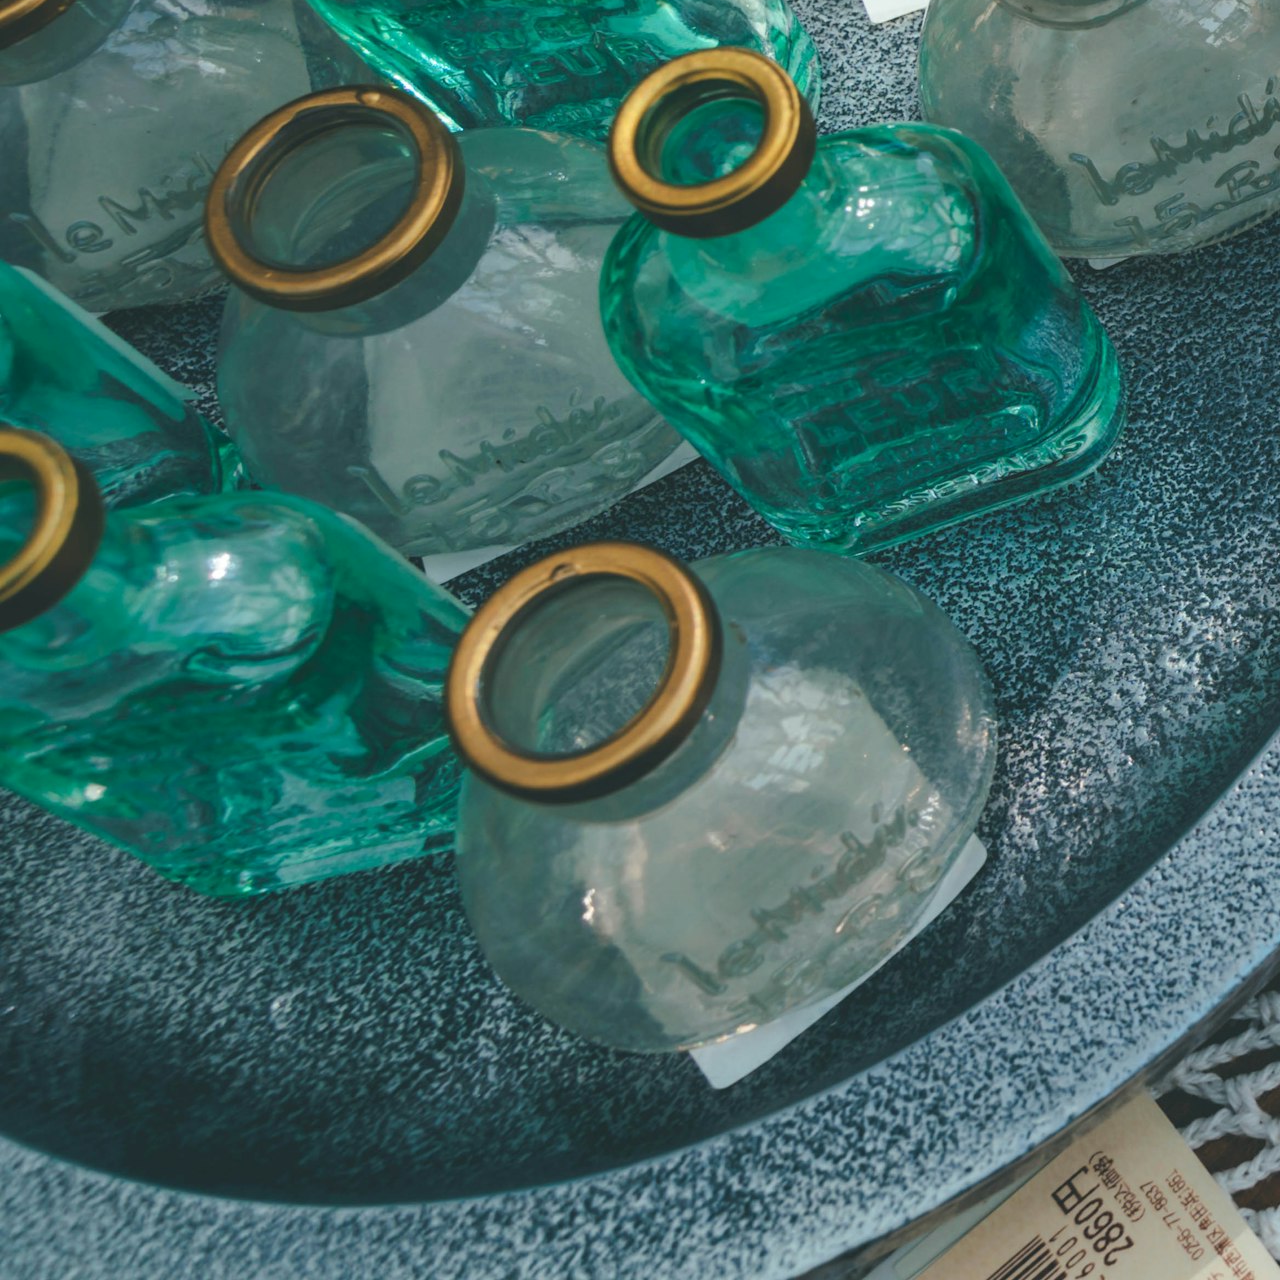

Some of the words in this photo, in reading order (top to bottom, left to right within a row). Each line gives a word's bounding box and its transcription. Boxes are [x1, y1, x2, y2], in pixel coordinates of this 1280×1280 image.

[1051, 1165, 1135, 1267] 2860円
[1088, 1150, 1147, 1223] (税込価格)
[1139, 1180, 1205, 1262] 0256-77-8637
